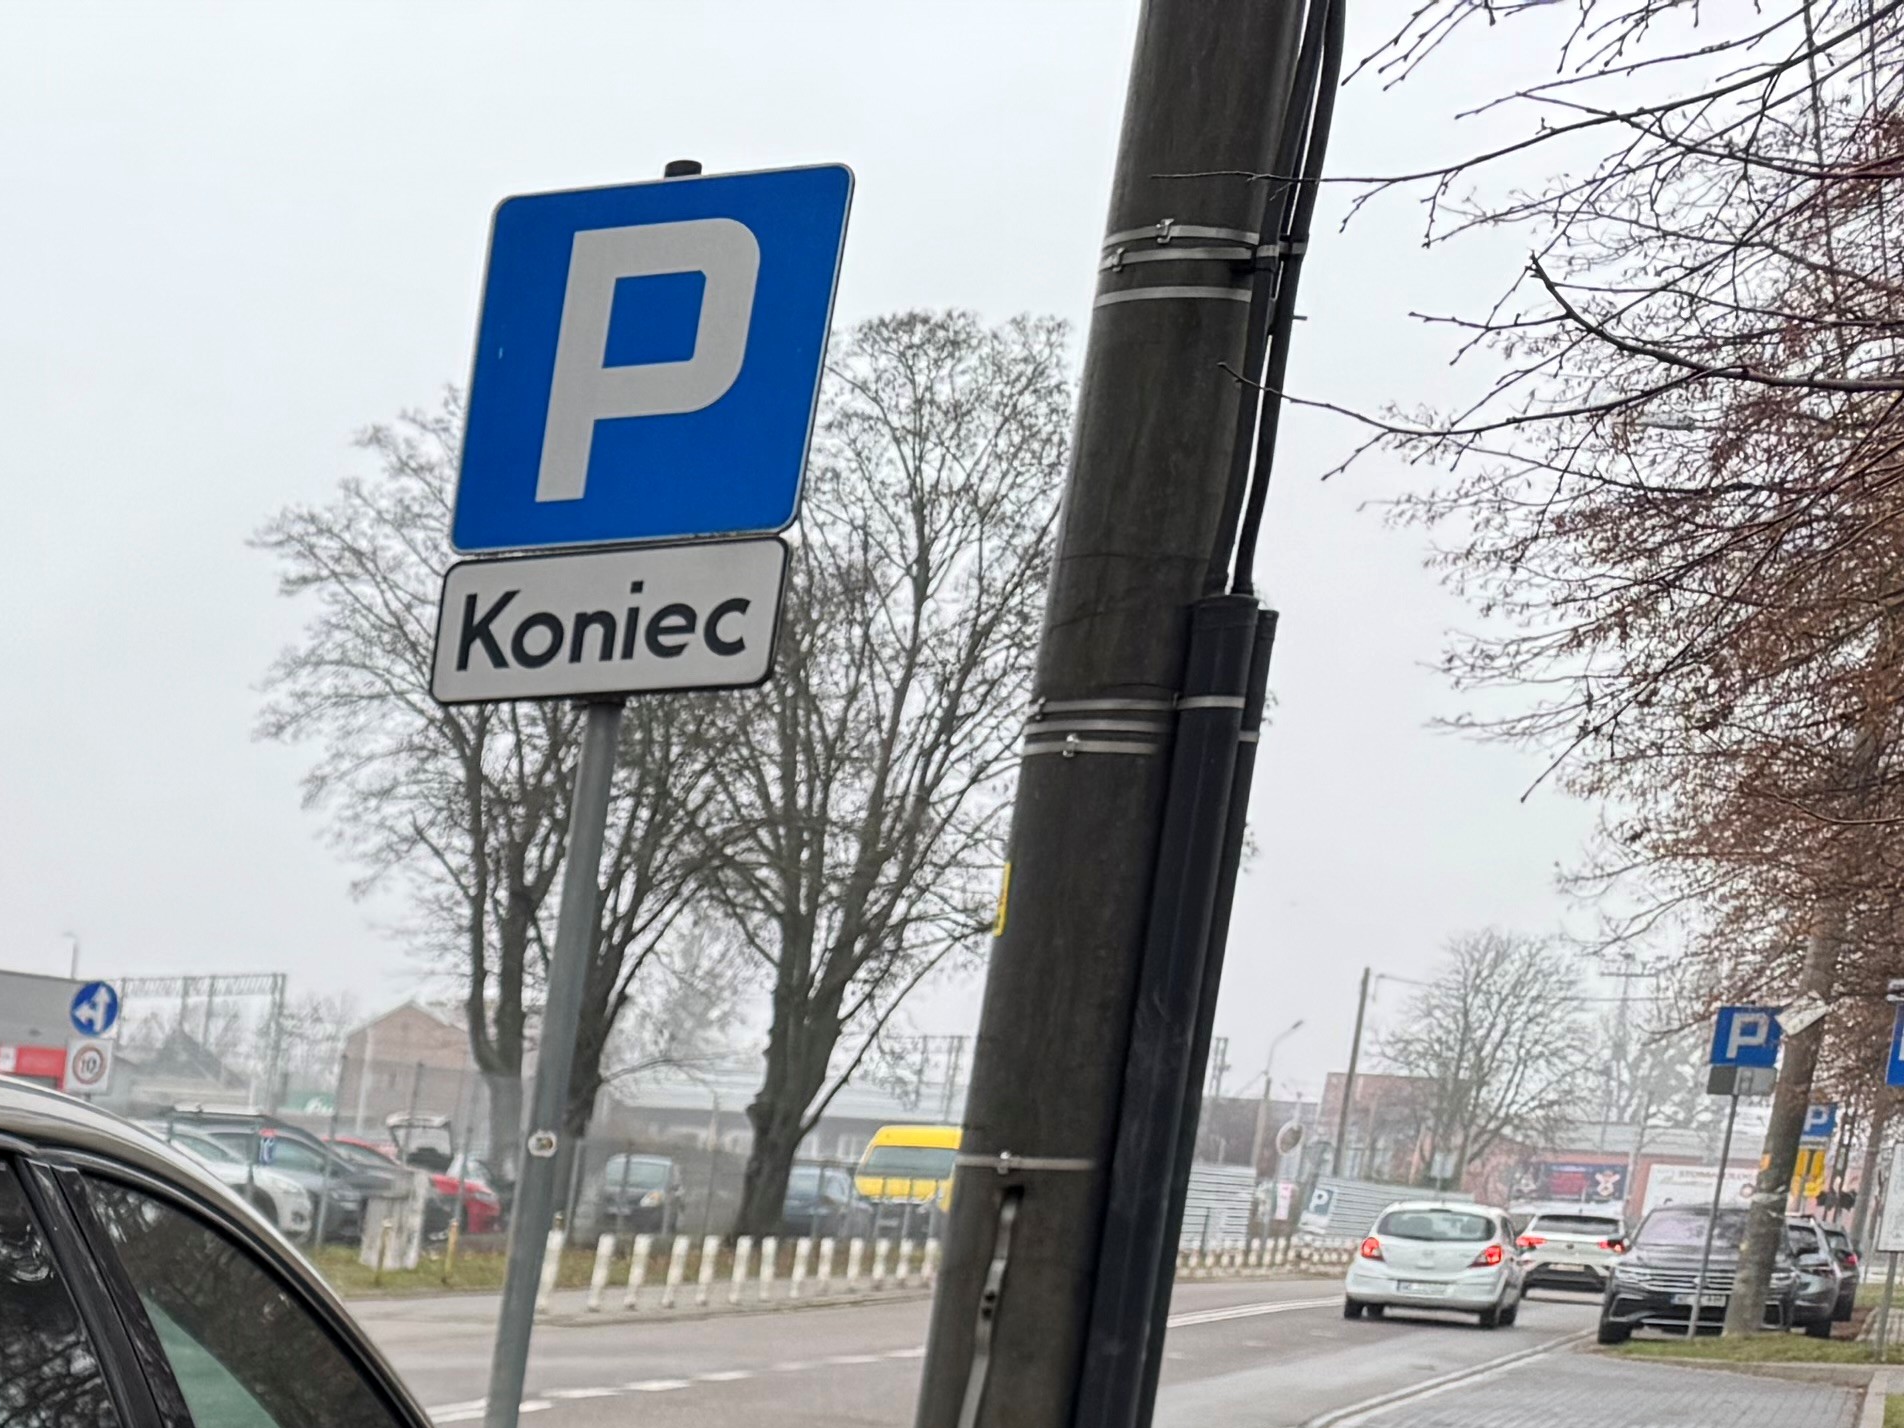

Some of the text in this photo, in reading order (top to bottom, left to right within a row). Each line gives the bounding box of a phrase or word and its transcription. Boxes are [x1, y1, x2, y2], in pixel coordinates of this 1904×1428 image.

[535, 217, 761, 503] P
[455, 579, 752, 672] Koniec
[1725, 1011, 1770, 1060] P
[1803, 1104, 1830, 1133] P
